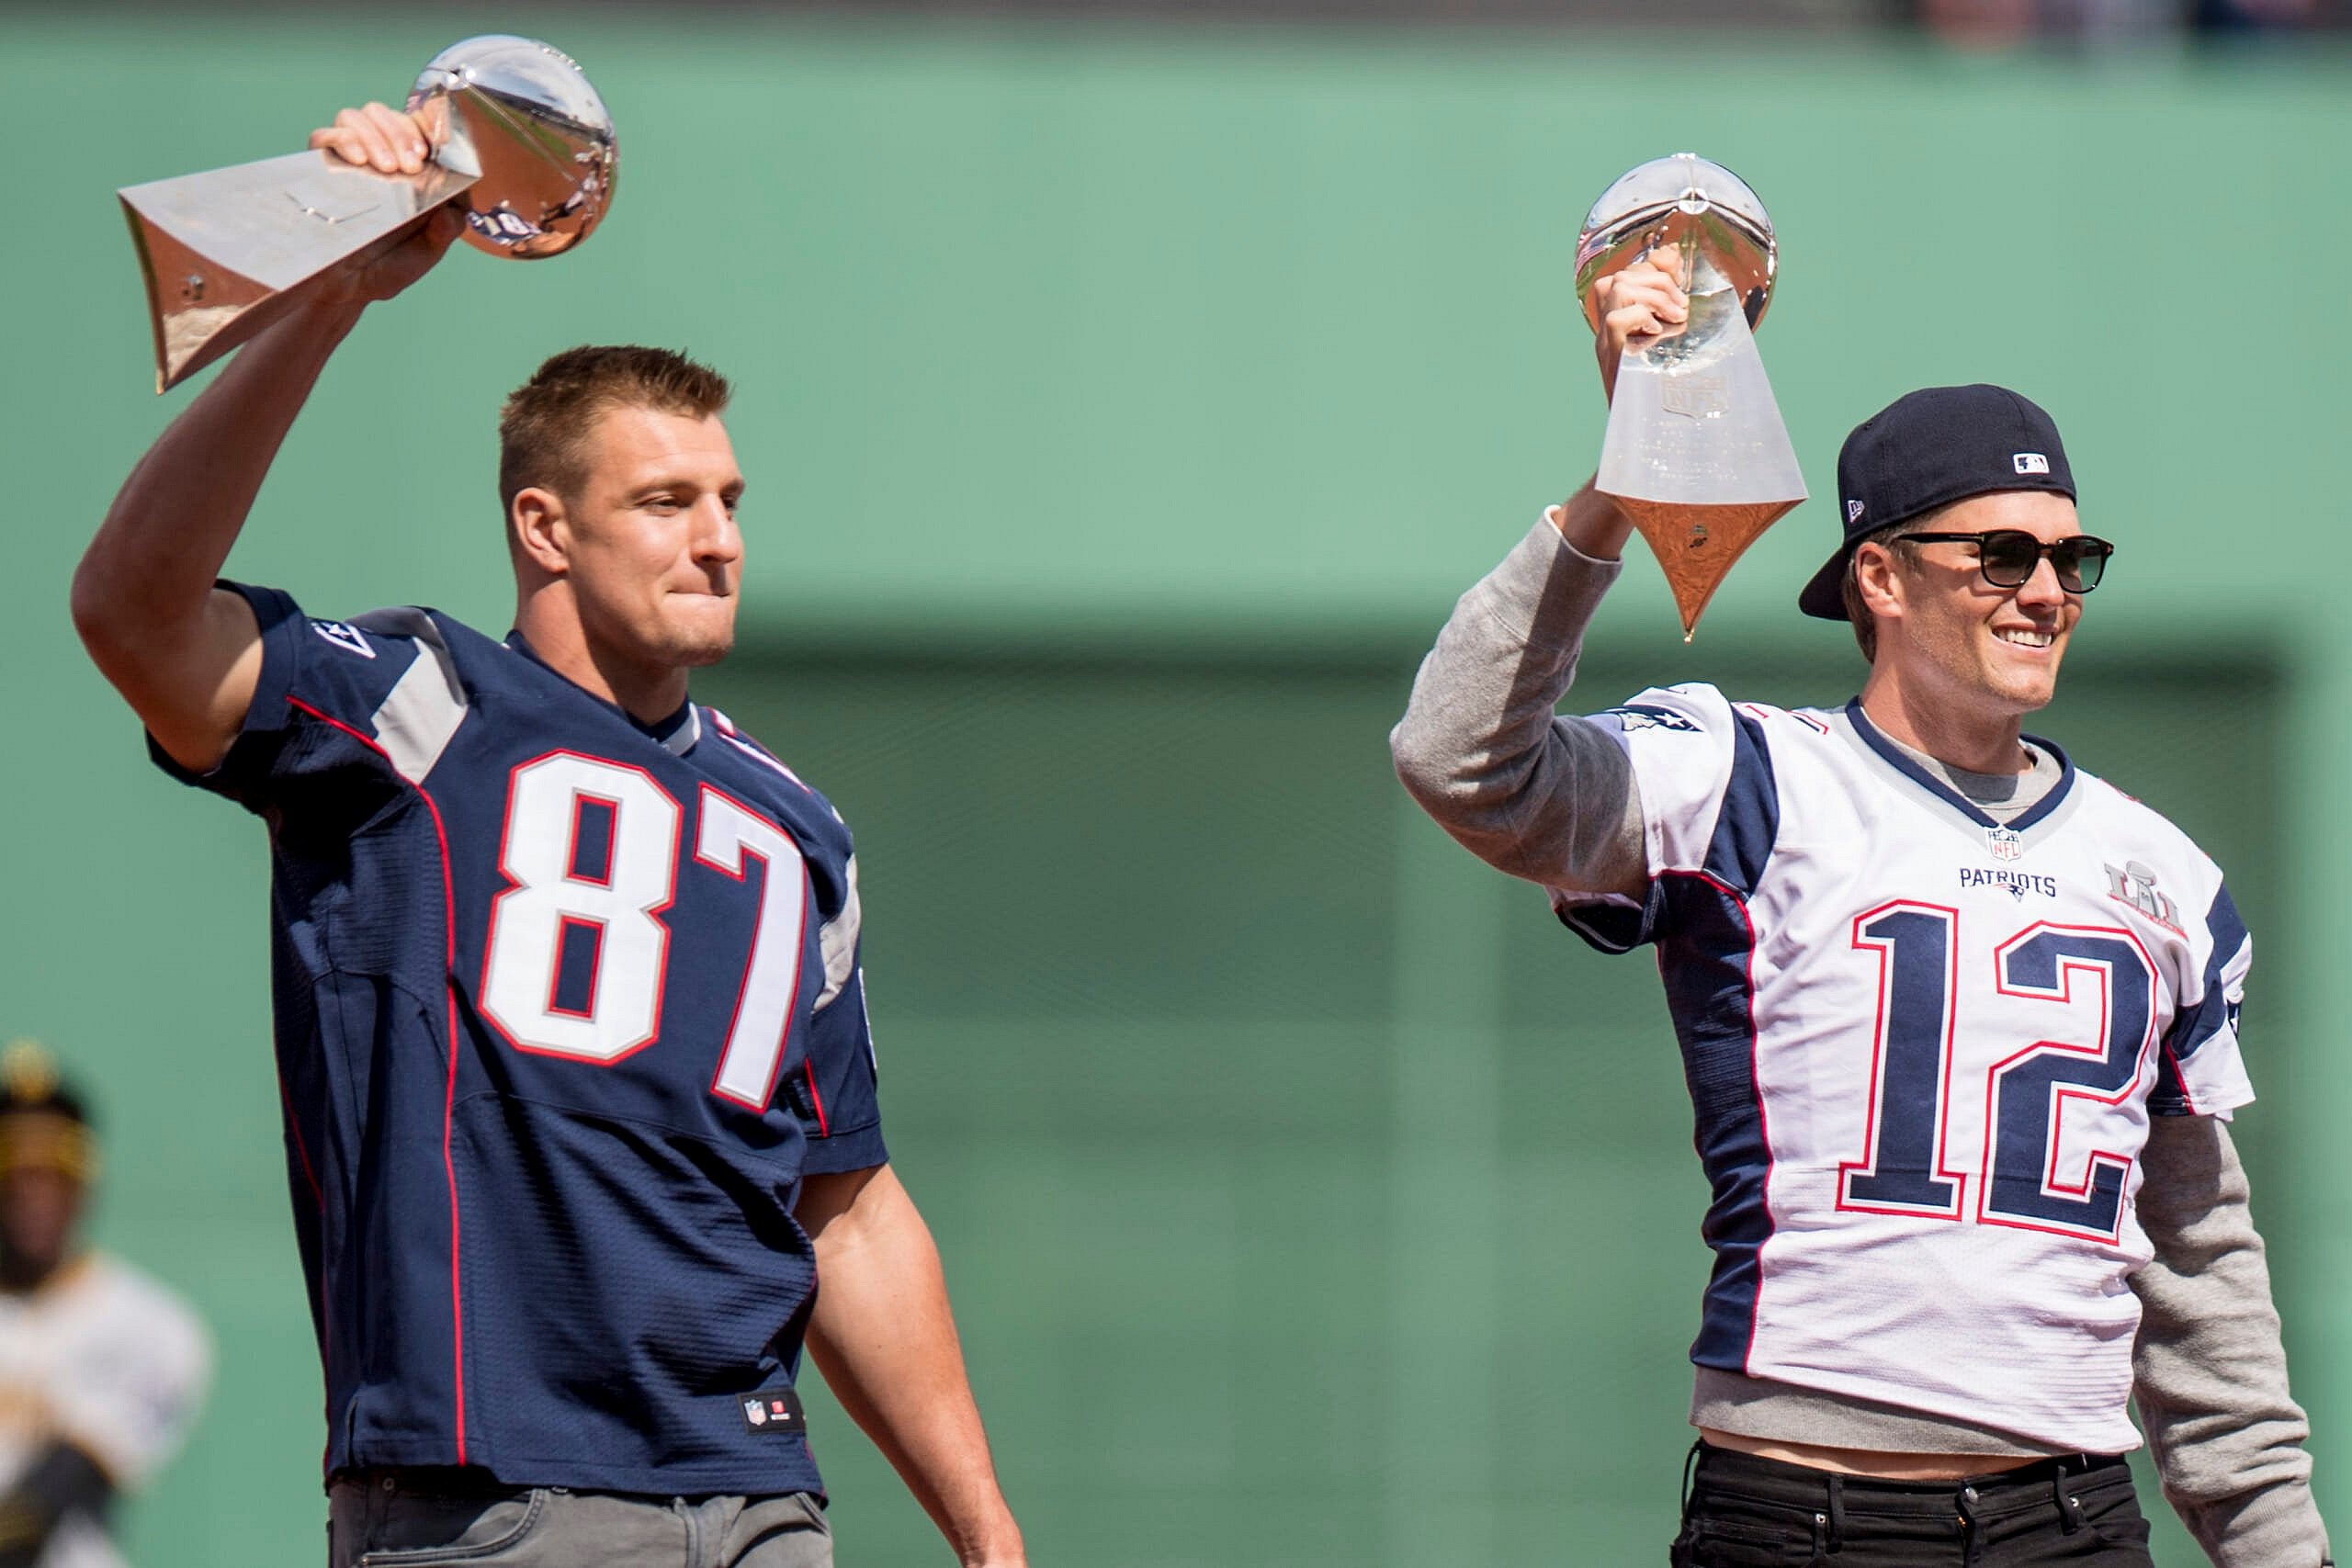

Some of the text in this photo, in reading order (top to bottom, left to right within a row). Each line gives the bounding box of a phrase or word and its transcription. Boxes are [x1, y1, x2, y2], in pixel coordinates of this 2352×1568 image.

[477, 748, 808, 1115] 87
[1960, 867, 2057, 897] PATRIOTS
[1993, 841, 2019, 859] NFL
[1835, 898, 2159, 1247] 12
